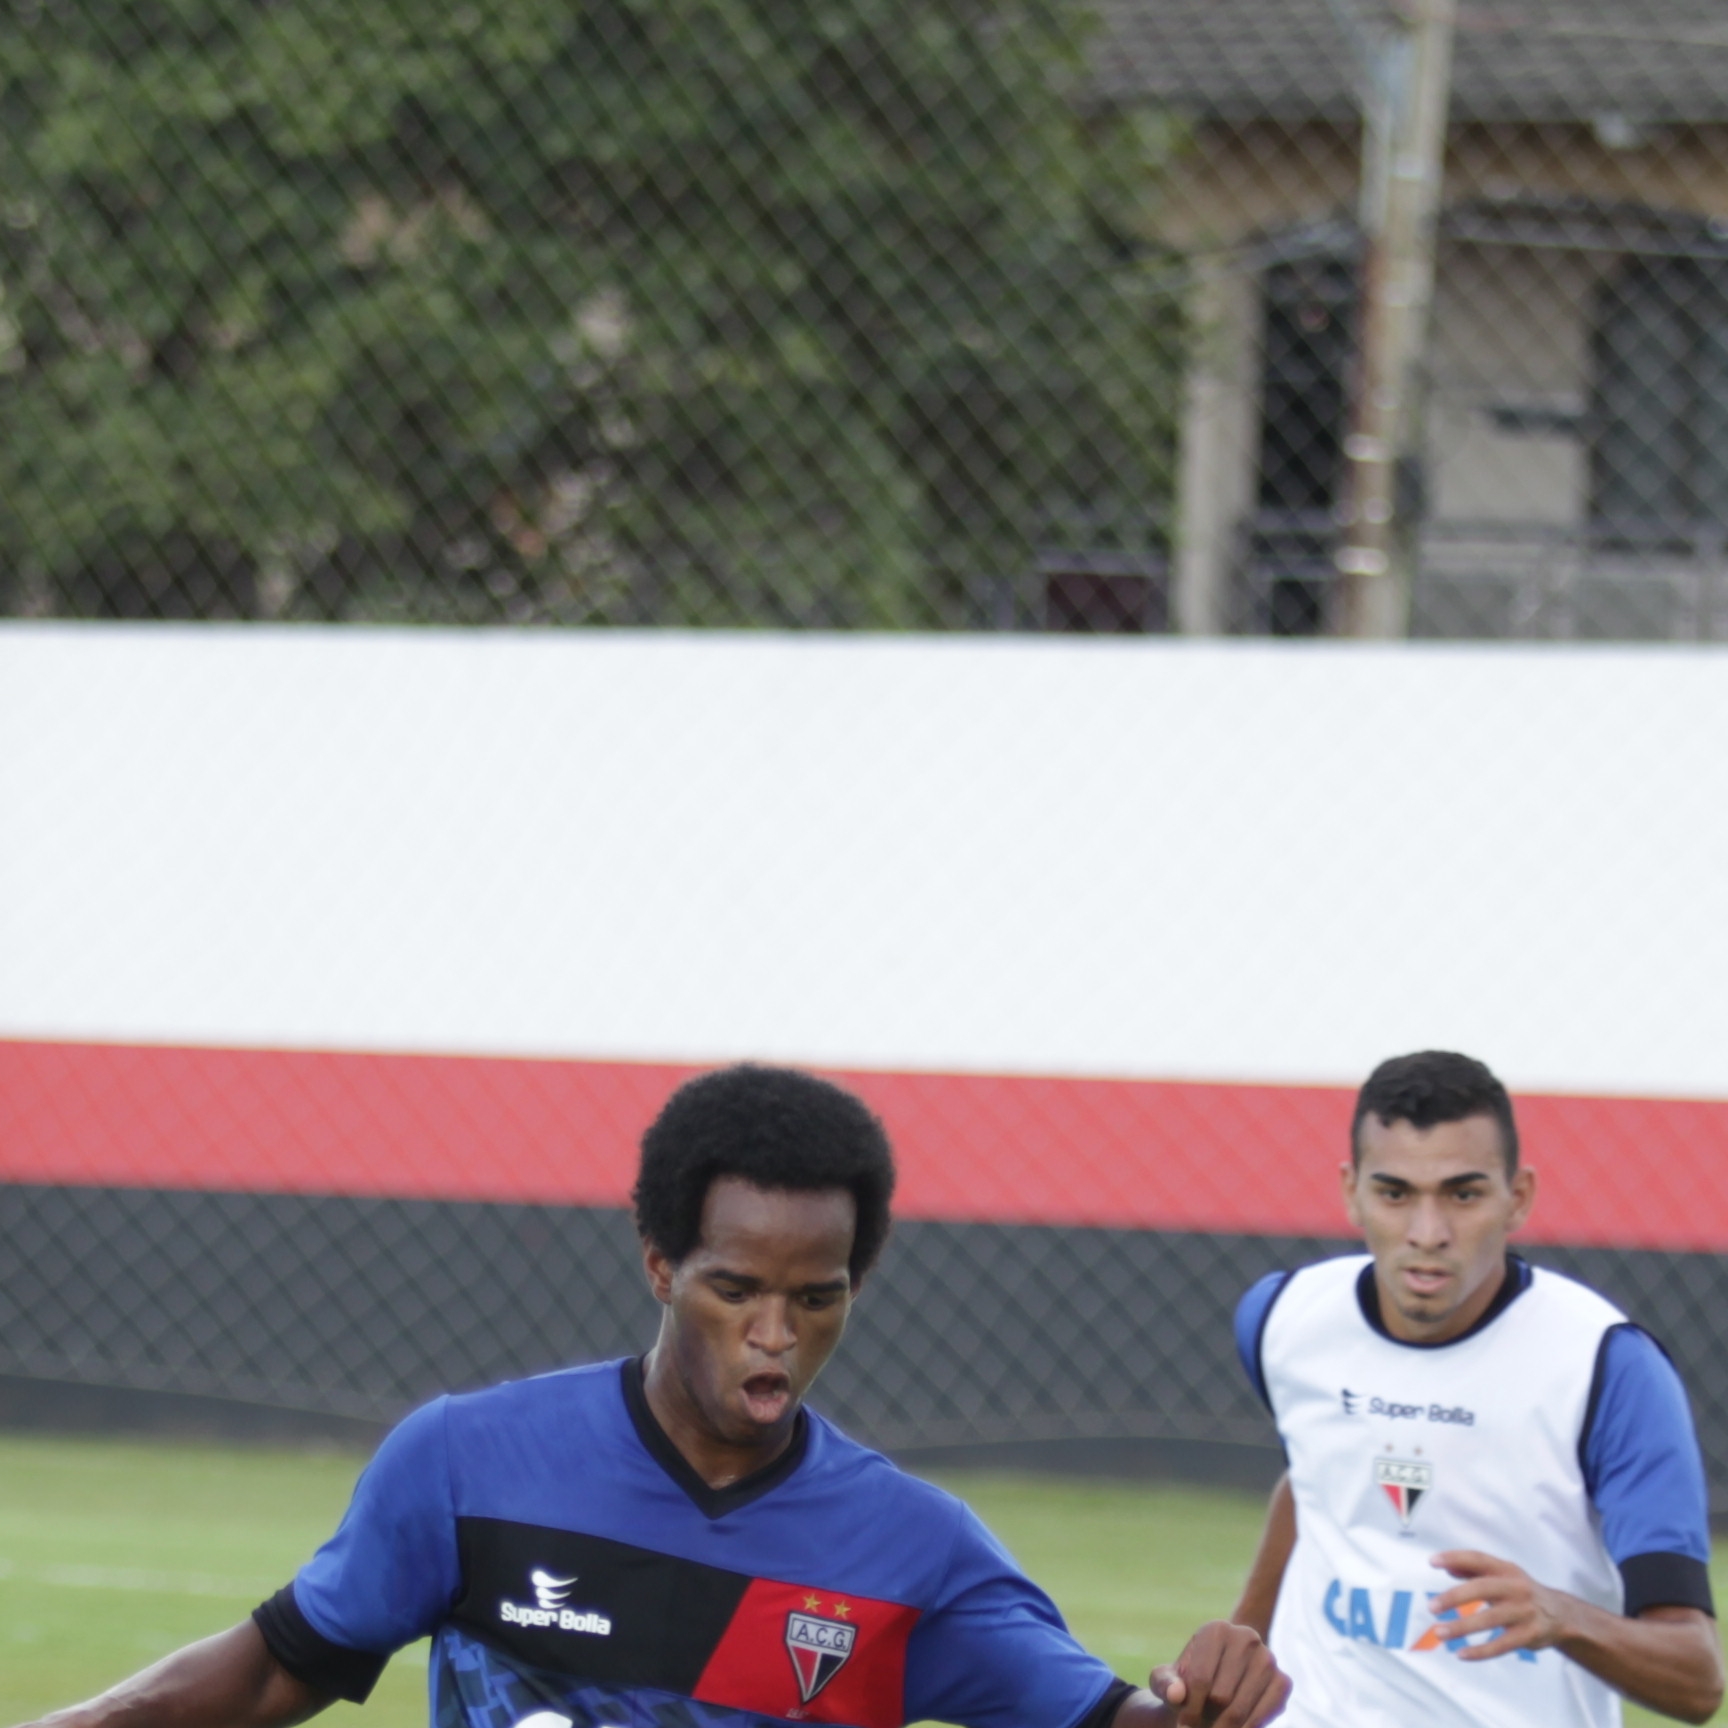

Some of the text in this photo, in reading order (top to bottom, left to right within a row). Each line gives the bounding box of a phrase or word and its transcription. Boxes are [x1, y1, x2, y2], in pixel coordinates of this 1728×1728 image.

[500, 1601, 612, 1636] Super Bolla
[796, 1623, 847, 1650] A.C.G.
